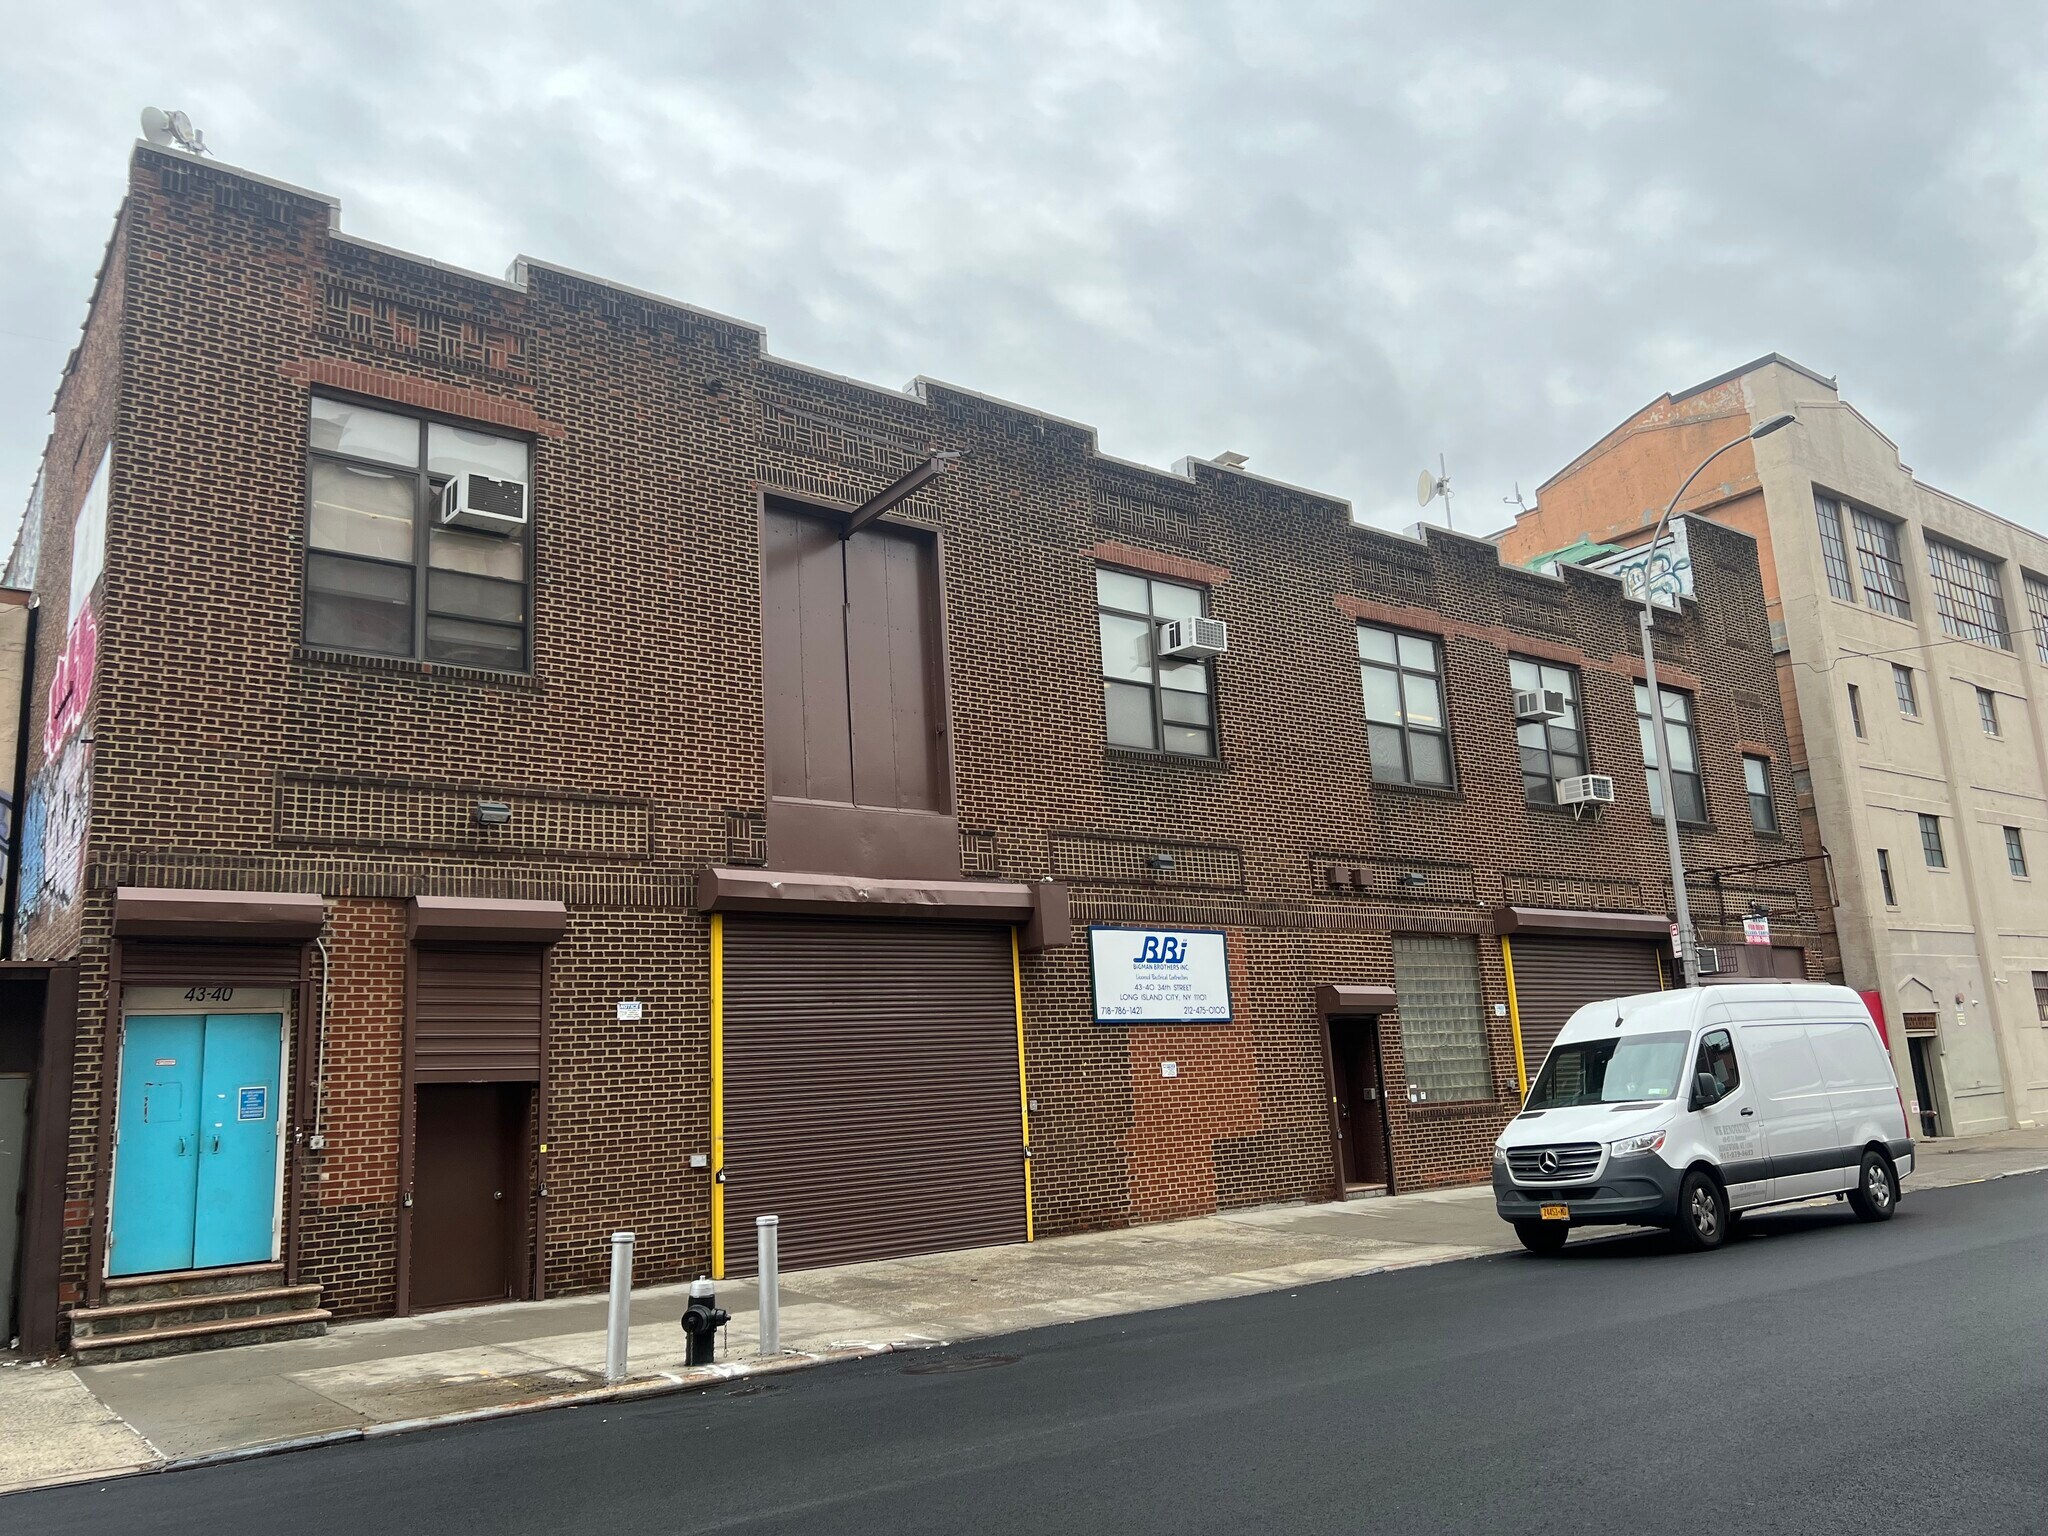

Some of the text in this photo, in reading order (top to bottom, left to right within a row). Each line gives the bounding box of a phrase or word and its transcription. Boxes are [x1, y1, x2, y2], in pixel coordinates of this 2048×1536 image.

[184, 987, 233, 1002] 43-40
[1120, 993, 1139, 1001] LONG
[1141, 993, 1163, 1001] ISLAND
[1183, 993, 1192, 1001] NY
[1101, 1006, 1143, 1015] 718-786-1421
[1183, 1006, 1226, 1015] 212-475-0100
